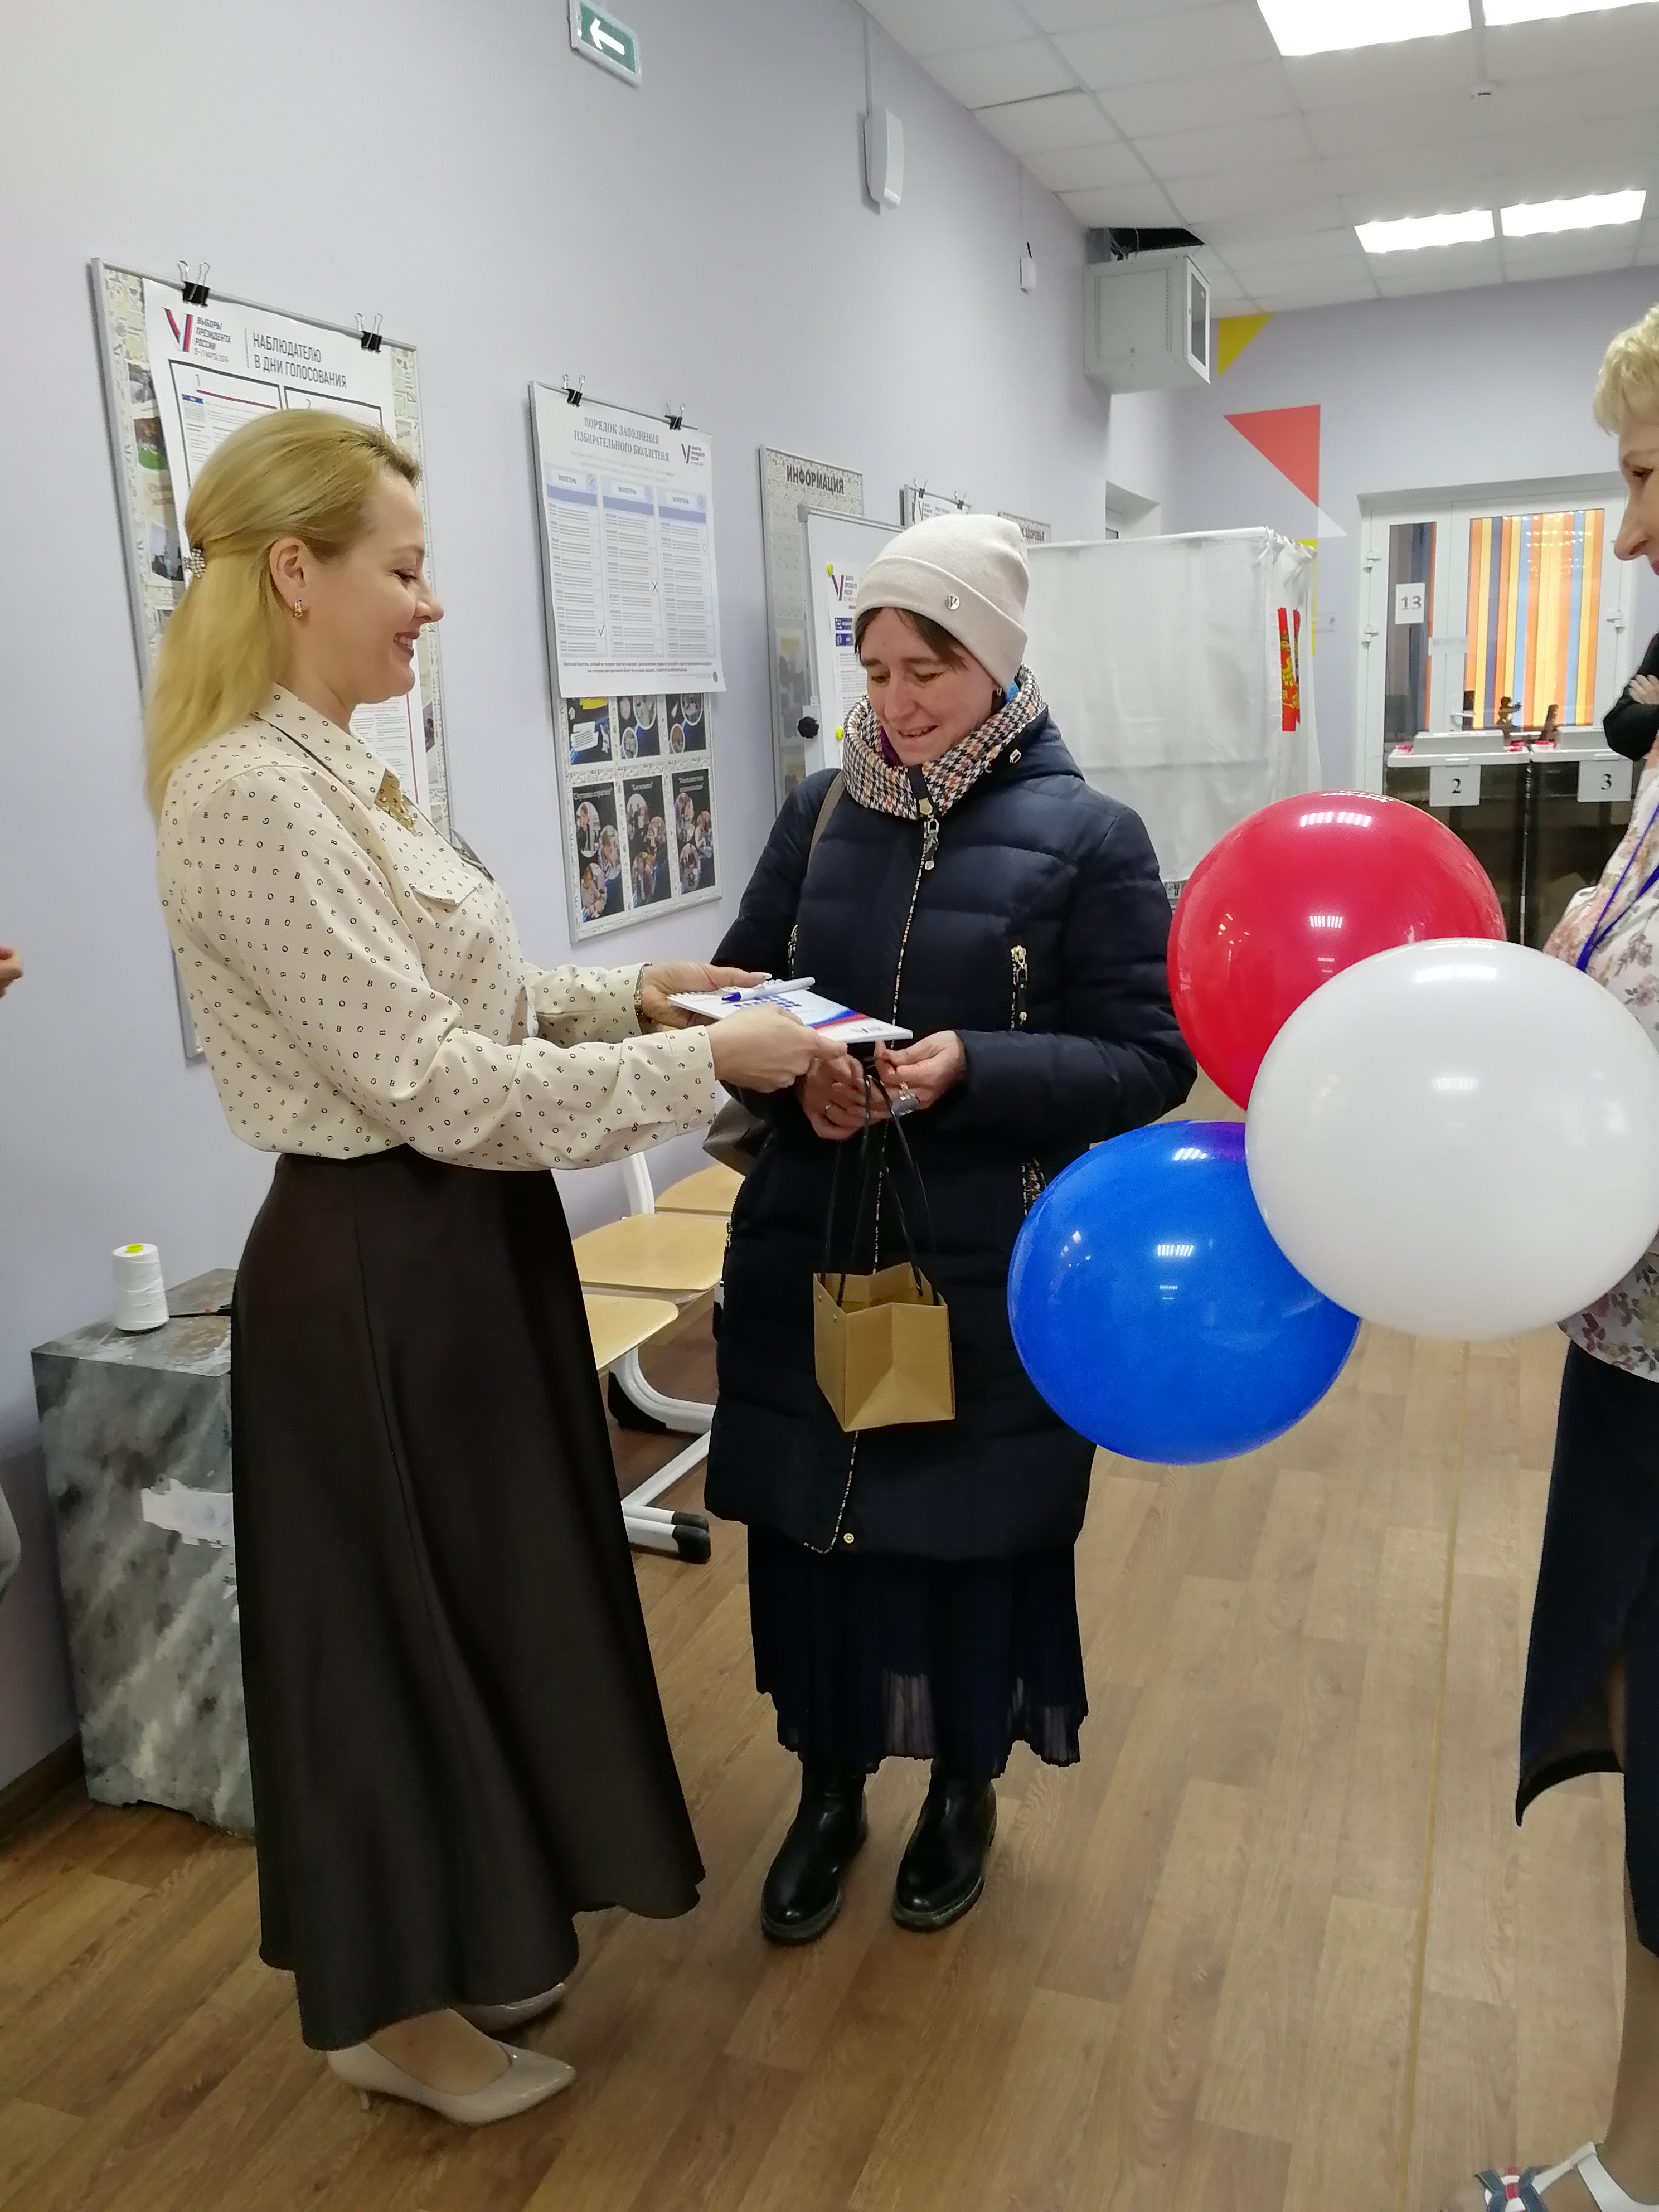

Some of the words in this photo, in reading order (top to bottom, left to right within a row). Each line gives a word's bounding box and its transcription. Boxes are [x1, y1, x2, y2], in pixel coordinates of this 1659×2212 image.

[197, 317, 222, 330] ВЫБОРЫ
[195, 337, 216, 351] РОССИИ
[196, 327, 231, 344] ПРЕЗИДЕНТА
[253, 333, 321, 363] НАБЛЮДАТЕЛЮ
[254, 354, 261, 369] В
[263, 356, 283, 375] ДНИ
[285, 361, 347, 389] ГОЛОСОВАНИЯ
[584, 417, 618, 434] ПОРЯДОК
[619, 425, 659, 445] ЗАПОЛНЕНИЯ
[574, 430, 632, 453] ИЗБИРАТЕЛЬНОГО
[633, 444, 670, 462] БЮЛЛЕТЕНЯ
[786, 465, 844, 496] ИНФОРМАЦИЯ
[1401, 595, 1422, 611] 13
[1452, 778, 1461, 794] 2
[1600, 773, 1612, 790] 3
